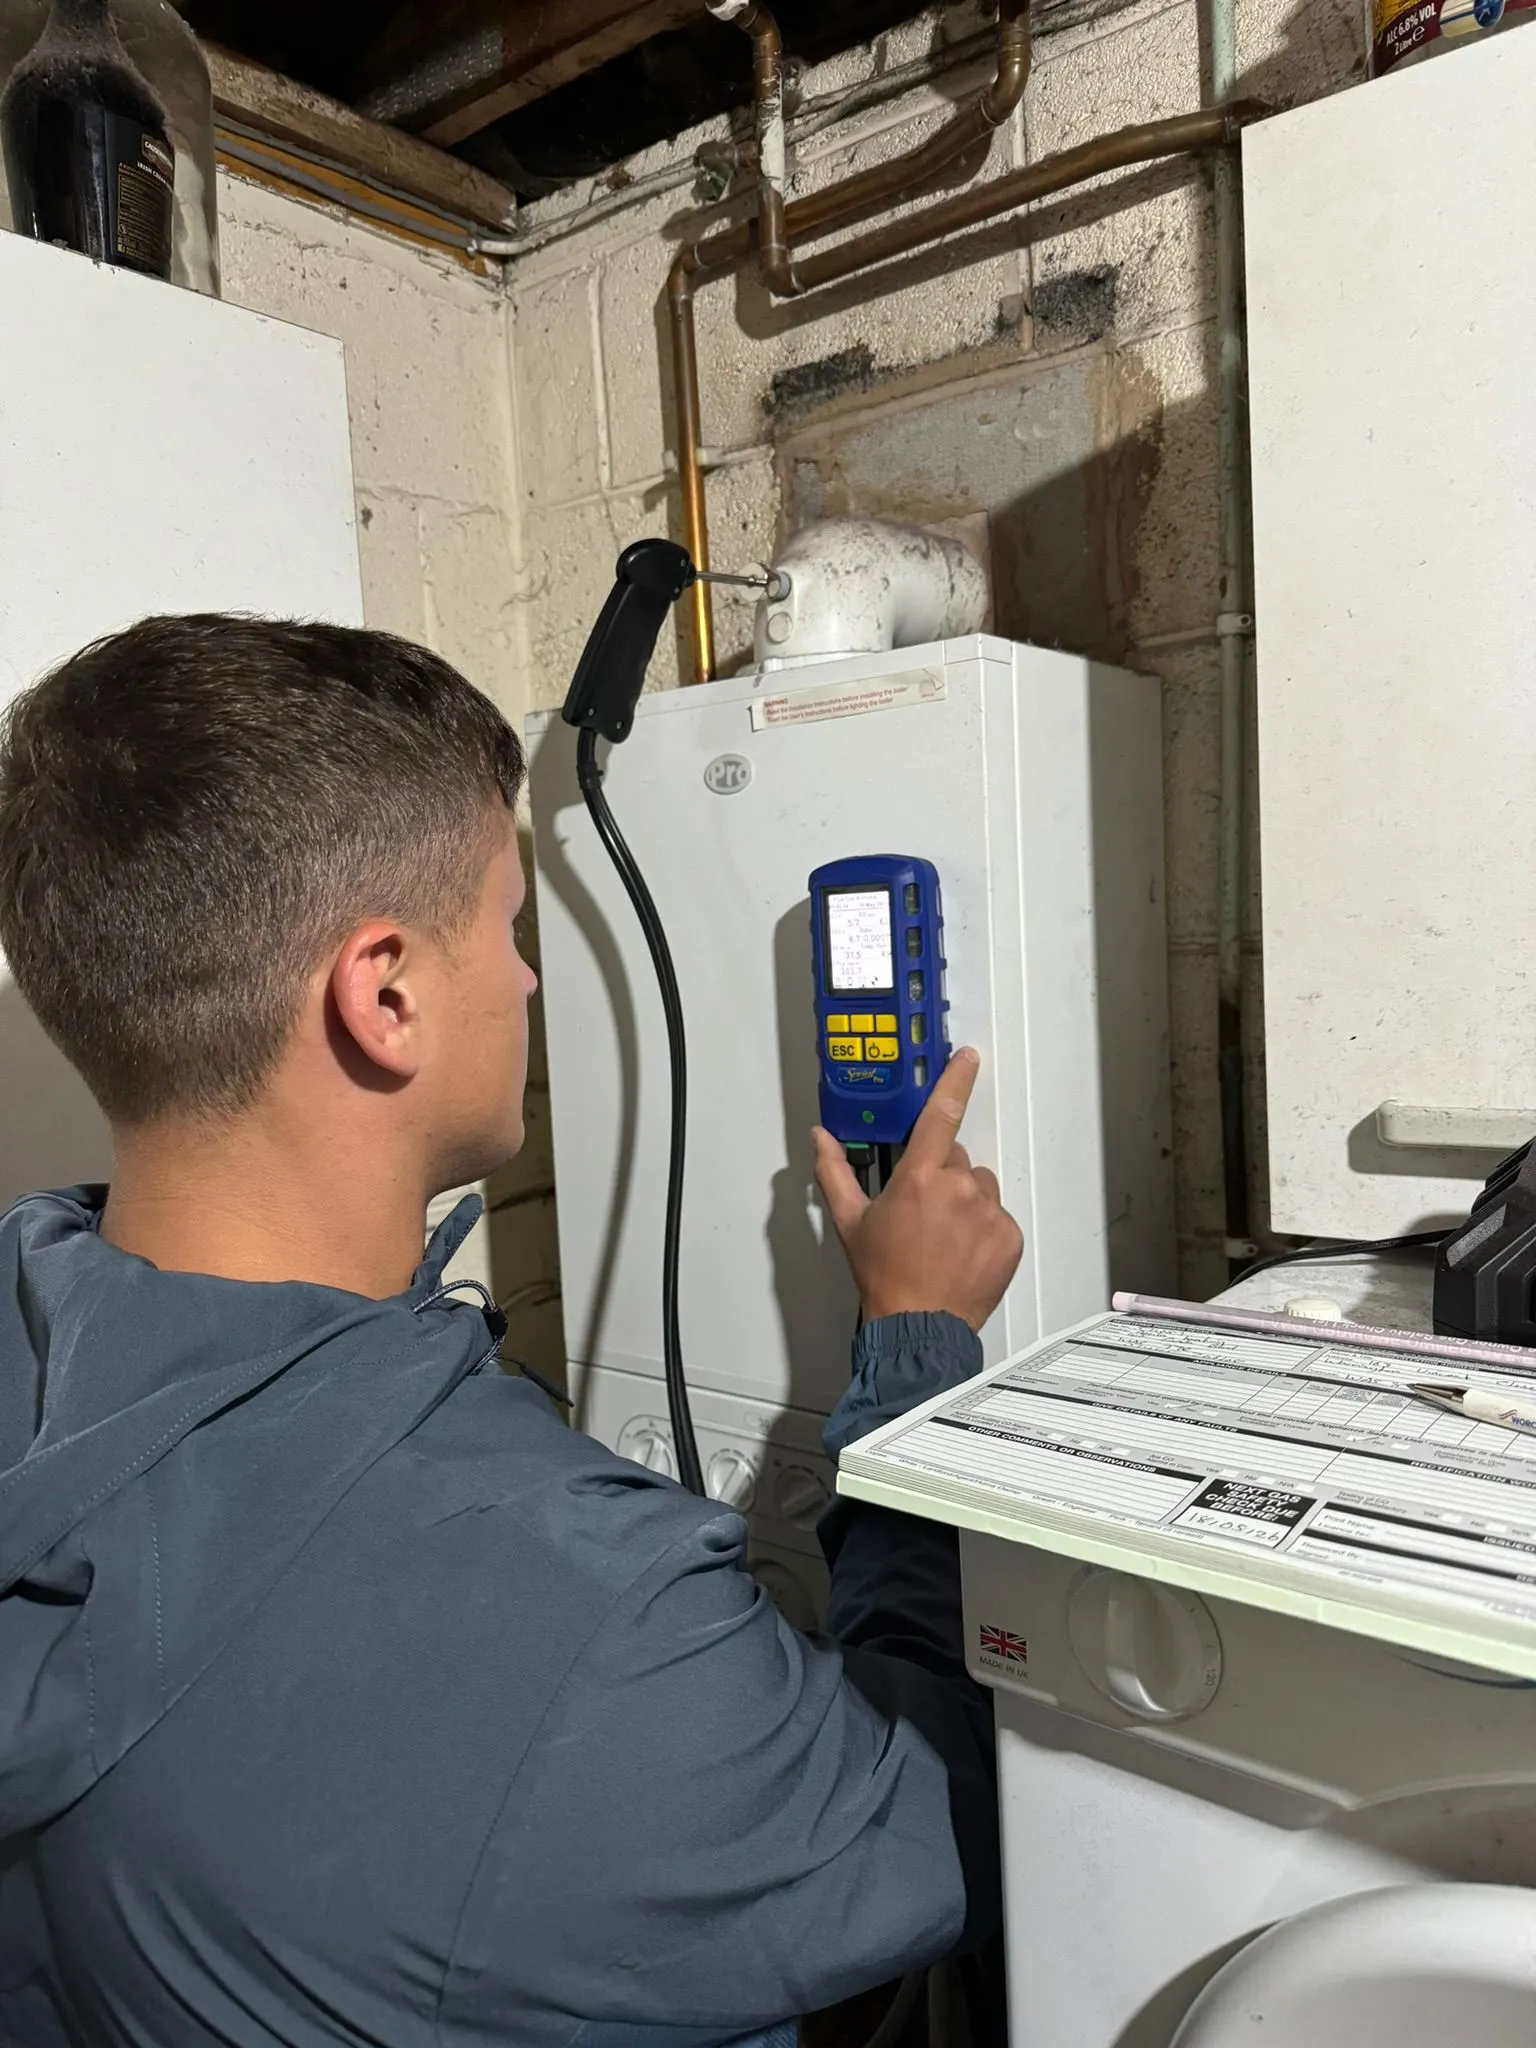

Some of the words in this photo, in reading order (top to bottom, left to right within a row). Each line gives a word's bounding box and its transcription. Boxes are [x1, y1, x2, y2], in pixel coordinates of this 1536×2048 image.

[1398, 12, 1419, 36] 6.8%
[1419, 2, 1437, 22] VOL
[832, 1045, 855, 1057] ESC
[1192, 1358, 1245, 1372] APPLIANCE
[1115, 1405, 1157, 1417] DETAILS
[1174, 1416, 1197, 1424] ANY
[1197, 1421, 1239, 1433] FAULTS
[967, 1425, 1002, 1438] OTHER
[1001, 1433, 1060, 1451] COMMENTS
[1059, 1446, 1076, 1454] OR
[1076, 1451, 1158, 1473] OBSERVATIONS
[1410, 1460, 1507, 1484] RECTIFICATION
[1223, 1482, 1268, 1495] NEXT
[1267, 1491, 1302, 1504] GAS
[1226, 1490, 1289, 1507] SAFETY
[1204, 1493, 1261, 1510] CHECK
[1261, 1505, 1300, 1519] DUE
[979, 1655, 1003, 1671] MADE
[1005, 1664, 1015, 1674] IN
[1017, 1669, 1030, 1679] UK
[1204, 1668, 1217, 1687] 120
